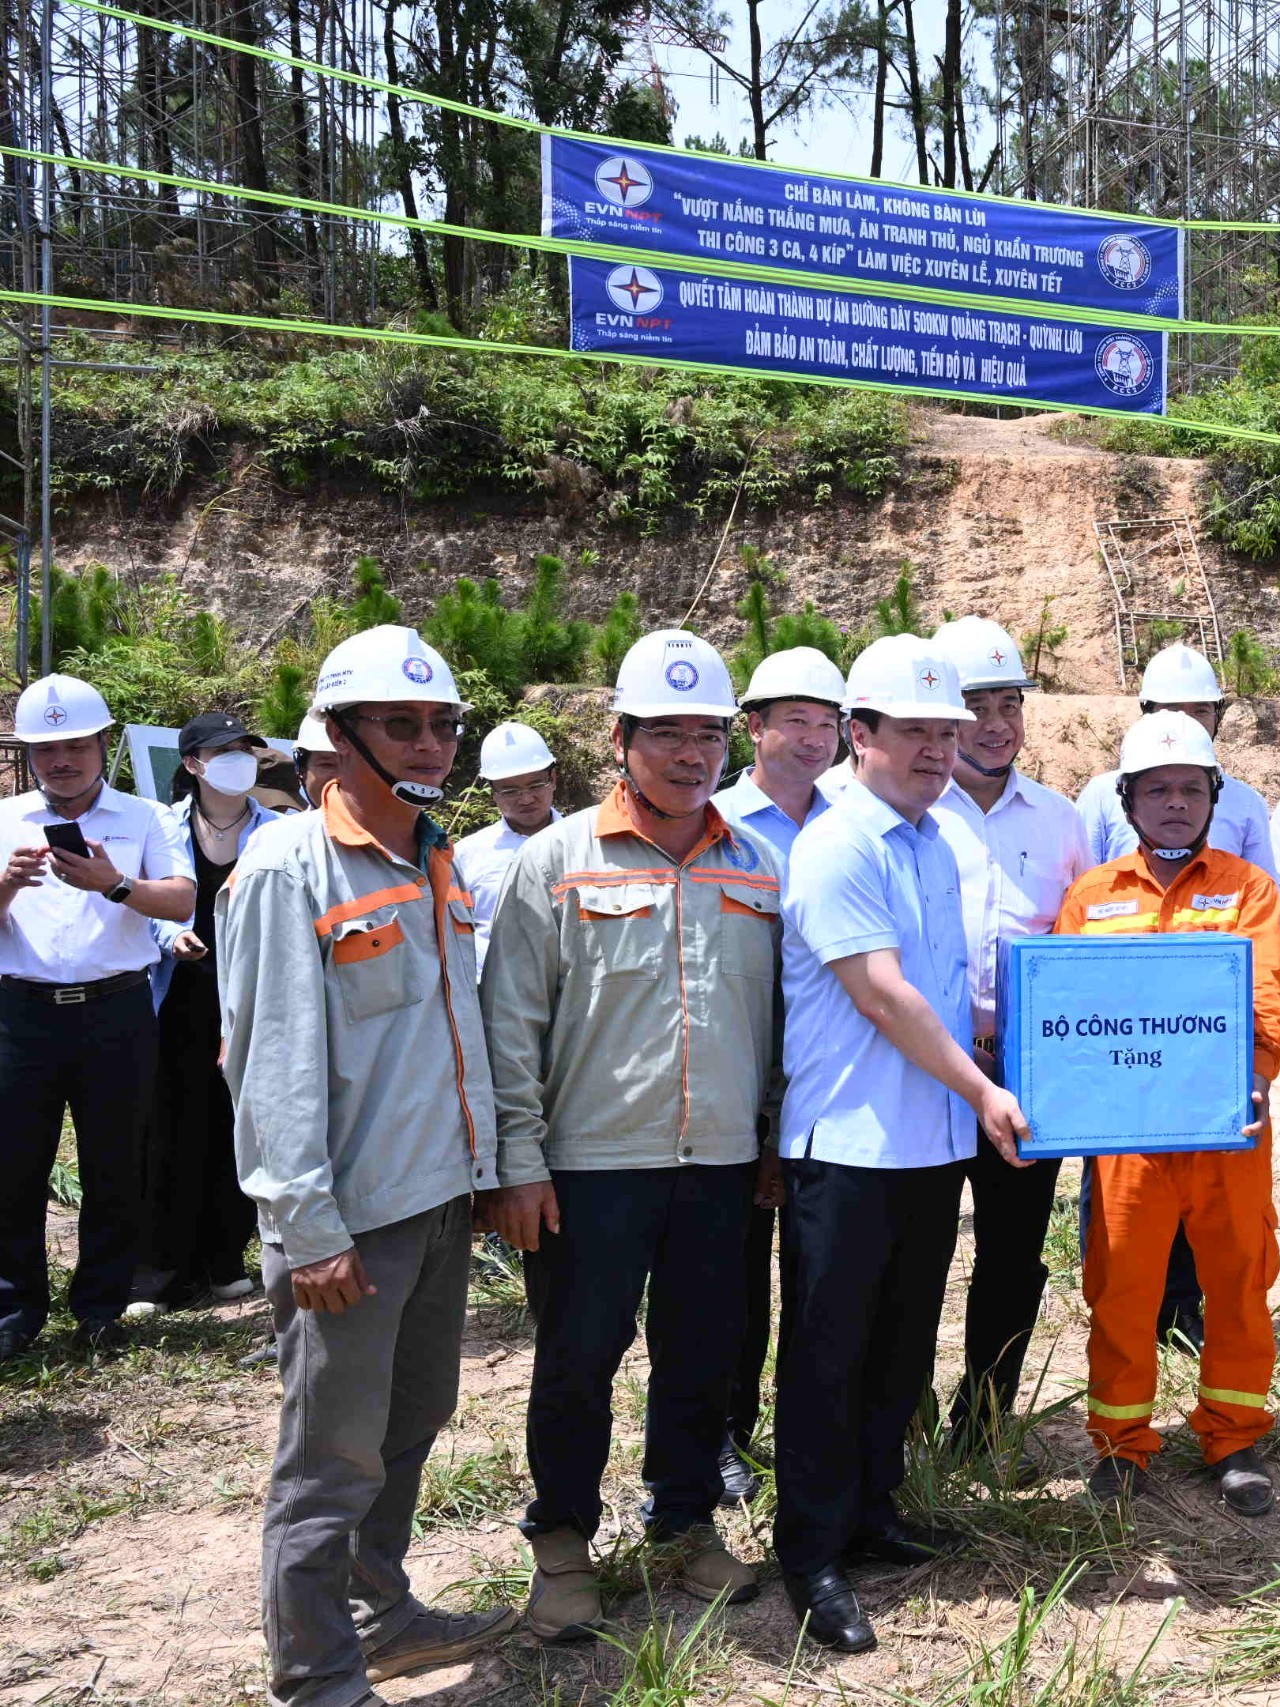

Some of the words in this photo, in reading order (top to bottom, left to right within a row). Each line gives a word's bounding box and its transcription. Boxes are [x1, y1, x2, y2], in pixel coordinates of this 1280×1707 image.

[723, 198, 763, 225] NẮNG
[768, 205, 814, 232] THẮNG
[819, 216, 854, 239] MƯA,
[859, 218, 878, 240] ĂN
[883, 224, 926, 246] TRANH
[930, 228, 959, 253] THỦ,
[964, 233, 990, 255] NGỦ
[994, 237, 1030, 261] KHẨN
[1034, 245, 1084, 268] TRƯƠNG
[785, 181, 808, 202] CHỈ
[813, 186, 842, 206] BÀN
[846, 190, 880, 214] LÀM,
[884, 198, 930, 219] KHÔNG
[934, 203, 961, 224] BÀN
[965, 208, 986, 227] LÙI
[698, 230, 720, 249] THI
[725, 231, 765, 256] CÔNG
[769, 239, 778, 257] 3
[782, 240, 805, 262] CA,
[810, 244, 818, 262] 4
[858, 247, 887, 271] LÀM
[891, 253, 921, 278] VIỆC
[925, 259, 968, 281] XUYÊN
[972, 260, 991, 287] LỄ,
[995, 268, 1037, 290] XUYÊN
[1041, 270, 1062, 293] TẾT
[679, 278, 714, 308] QUYẾT
[717, 282, 741, 311] TÂM
[744, 287, 775, 315] HOÀN
[778, 291, 814, 320] THÀNH
[816, 298, 831, 327] DỰ
[834, 297, 849, 324] ÁN
[852, 300, 888, 329] ĐƯỜNG
[890, 305, 910, 331] DÂY
[952, 311, 986, 341] QUẢNG
[988, 320, 1020, 349] TRẠCH
[1030, 324, 1062, 351] QUỲNH
[746, 323, 771, 357] ĐẢM
[774, 326, 796, 359] BẢO
[799, 336, 814, 362] AN
[817, 335, 848, 368] TOÀN,
[852, 336, 879, 369] CHẤT
[881, 345, 918, 377] LƯỢNG,
[921, 345, 944, 377] TIẾN
[947, 350, 960, 384] ĐỘ
[963, 352, 975, 381] VÀ
[981, 355, 1004, 388] HIỆU
[1007, 356, 1026, 388] QUẢ
[1042, 1015, 1069, 1041] BỘ
[1076, 1014, 1133, 1037] CÔNG
[1139, 1014, 1226, 1035] THƯƠNG
[1109, 1048, 1162, 1069] Tặng
